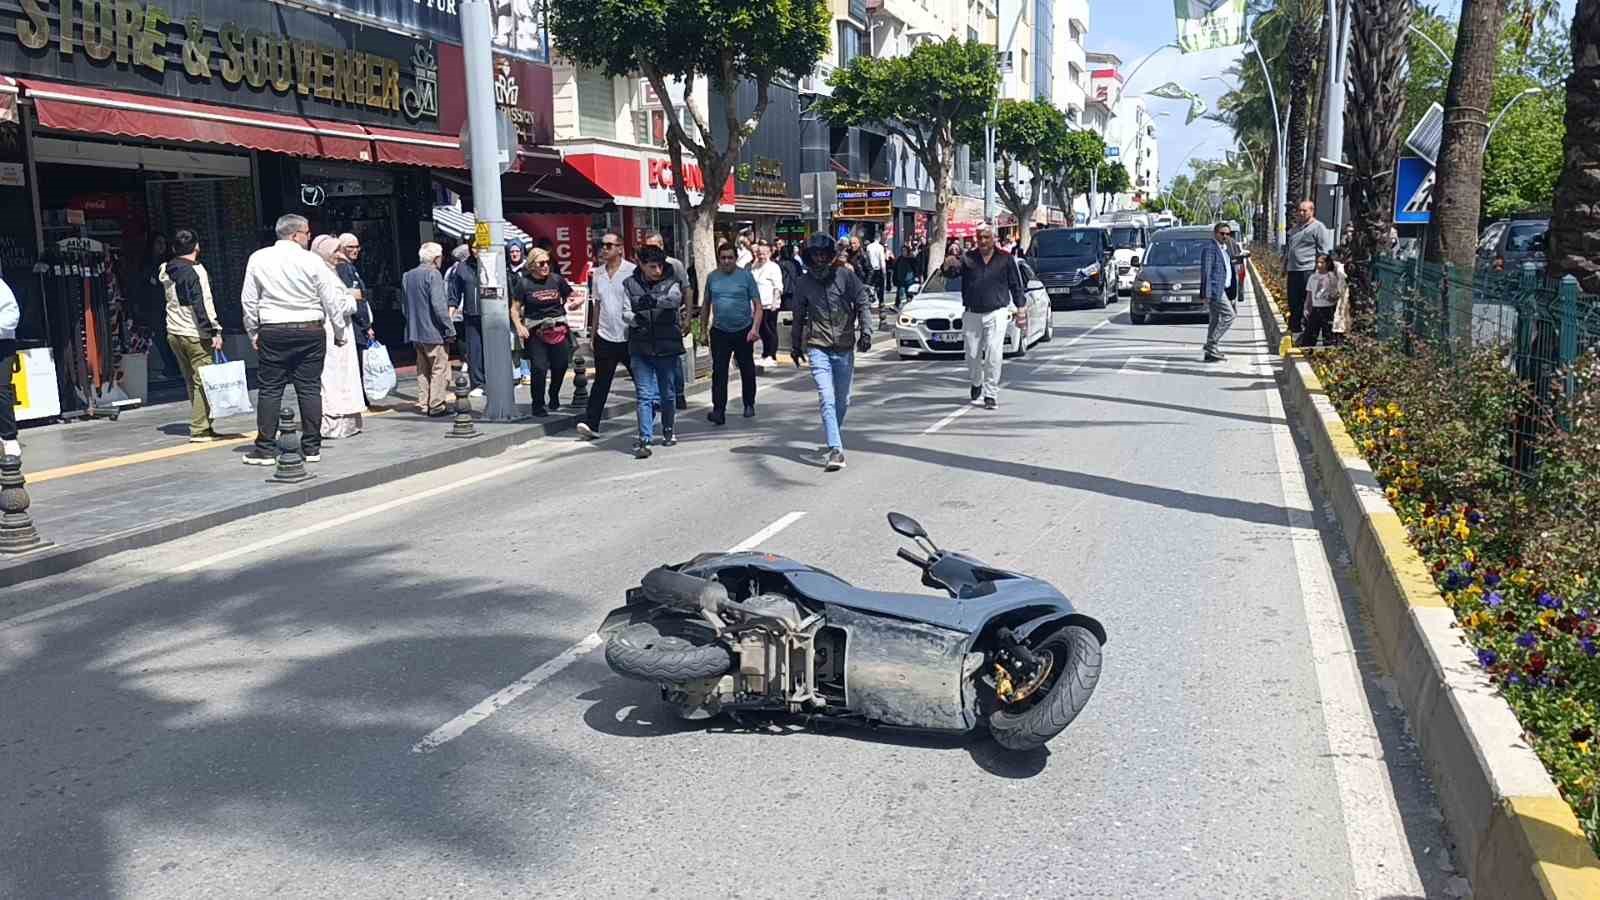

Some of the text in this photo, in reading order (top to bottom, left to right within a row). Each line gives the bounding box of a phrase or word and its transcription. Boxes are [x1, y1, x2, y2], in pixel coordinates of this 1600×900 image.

[16, 0, 401, 111] STORE & SOUVENIER
